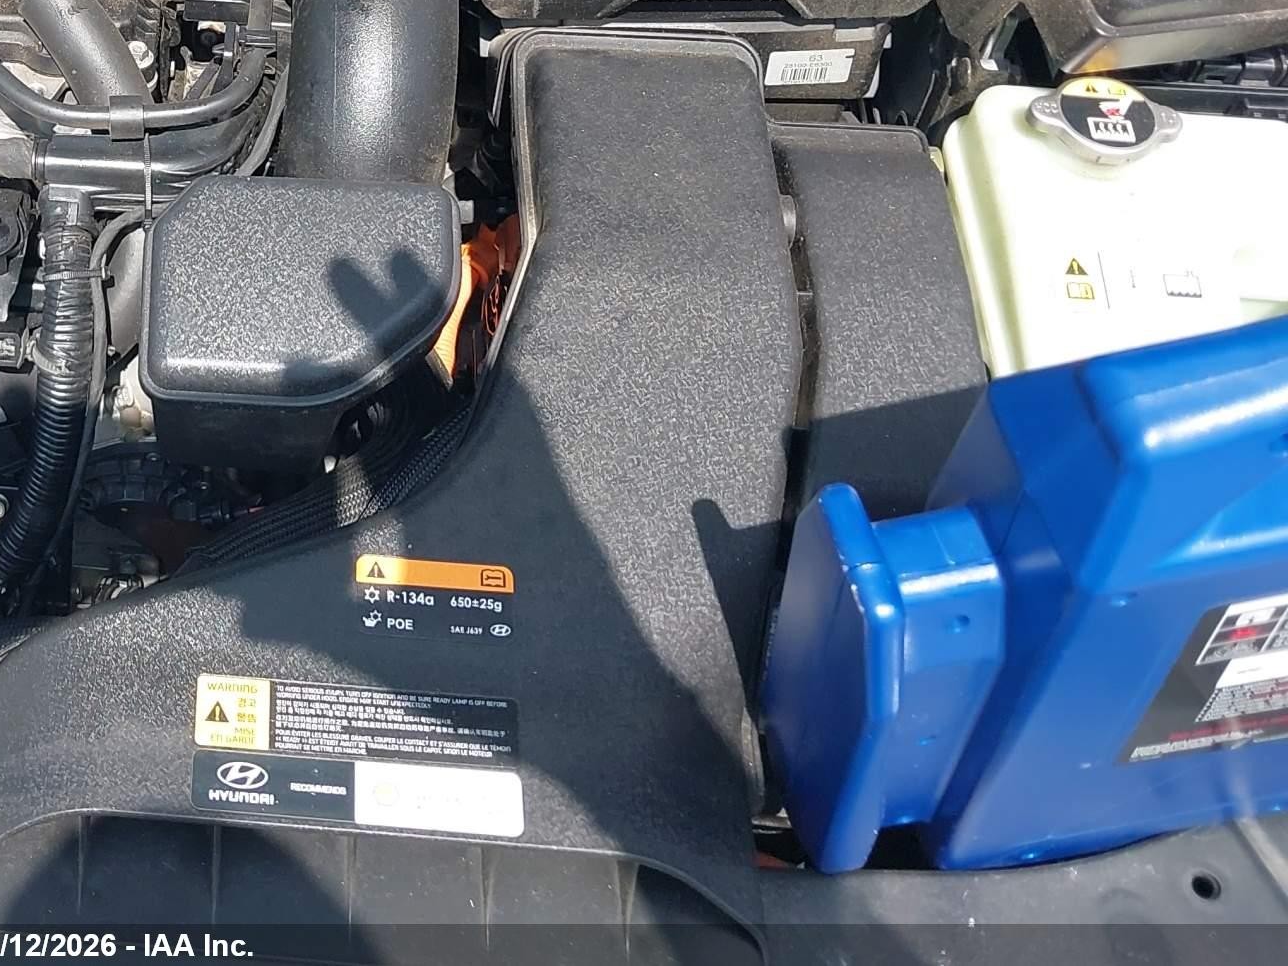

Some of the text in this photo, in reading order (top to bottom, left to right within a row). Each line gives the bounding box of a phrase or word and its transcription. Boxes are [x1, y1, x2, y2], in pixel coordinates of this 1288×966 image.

[386, 590, 503, 612] R-134a 650±25g
[386, 617, 414, 631] POE
[207, 682, 259, 694] WARNING
[289, 782, 348, 795] RECOMMENDS
[208, 788, 275, 806] HYUNDAI
